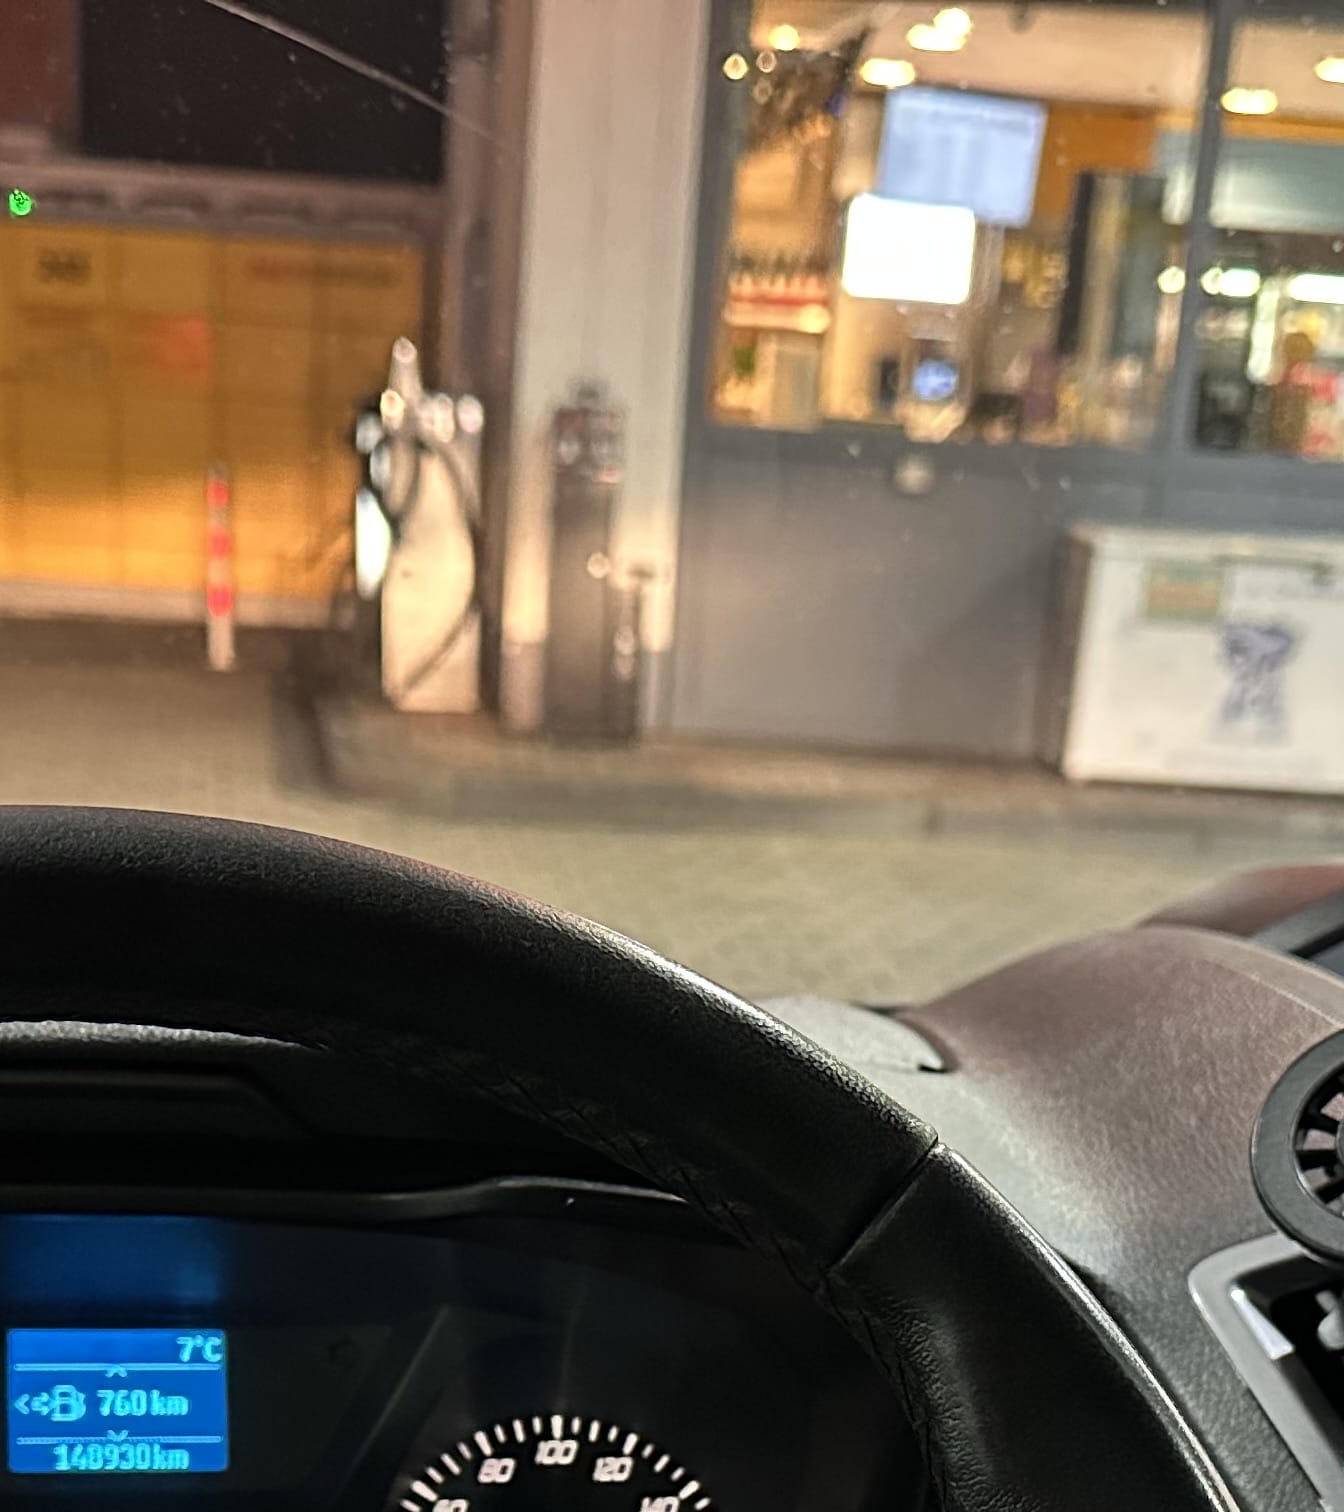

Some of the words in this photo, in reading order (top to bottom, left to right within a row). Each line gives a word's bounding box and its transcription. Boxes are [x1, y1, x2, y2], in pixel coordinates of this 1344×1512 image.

[176, 1335, 223, 1362] 7°C
[96, 1389, 147, 1417] 760
[150, 1389, 189, 1416] km
[534, 1439, 579, 1466] 100
[592, 1456, 634, 1483] 120
